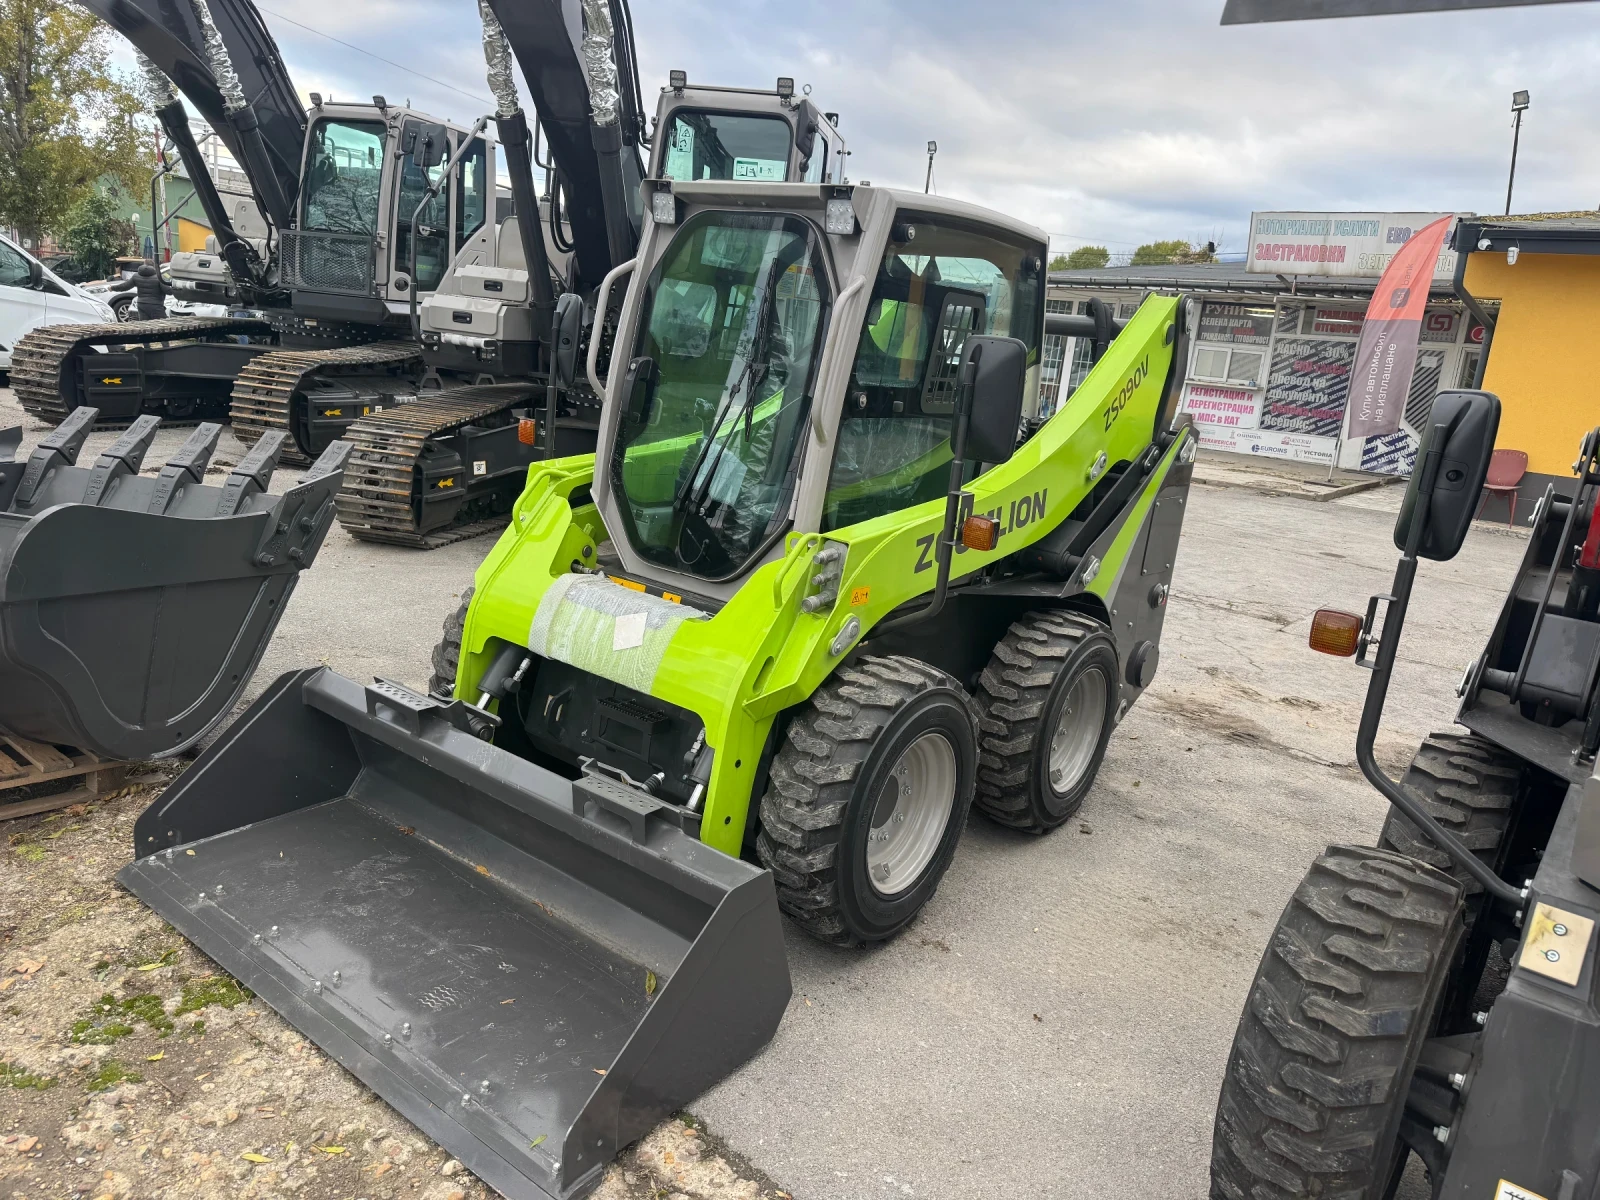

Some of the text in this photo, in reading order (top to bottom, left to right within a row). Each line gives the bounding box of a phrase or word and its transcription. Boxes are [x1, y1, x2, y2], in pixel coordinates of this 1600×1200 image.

[1256, 219, 1380, 237] НОТАРИАЛНИ УСЛУГИ
[1386, 227, 1412, 243] ЕКО
[1255, 243, 1346, 262] ЗАСТРАХОВКИ
[1359, 253, 1394, 270] ЗЕЛЕ
[1402, 264, 1413, 285] bank
[1201, 316, 1252, 328] ЗЕЛЕНА КАРТА
[1316, 309, 1366, 321] ГРАЖДАНС
[1276, 343, 1349, 359] КАСКО -30%
[1359, 395, 1373, 421] Купи
[1367, 332, 1387, 392] автомобил
[1374, 343, 1397, 422] на изплащане
[1103, 354, 1148, 433] ZS090V
[1190, 386, 1246, 400] РЕГИСТРАЦИЯ
[1187, 399, 1254, 414] ДЕРЕГИСТРАЦИЯ
[1197, 413, 1216, 422] МПС
[1224, 415, 1240, 425] КАТ
[1198, 437, 1236, 446] NTERAMERICAN
[1261, 446, 1288, 454] EUROINS
[1304, 450, 1333, 458] VICTORIA
